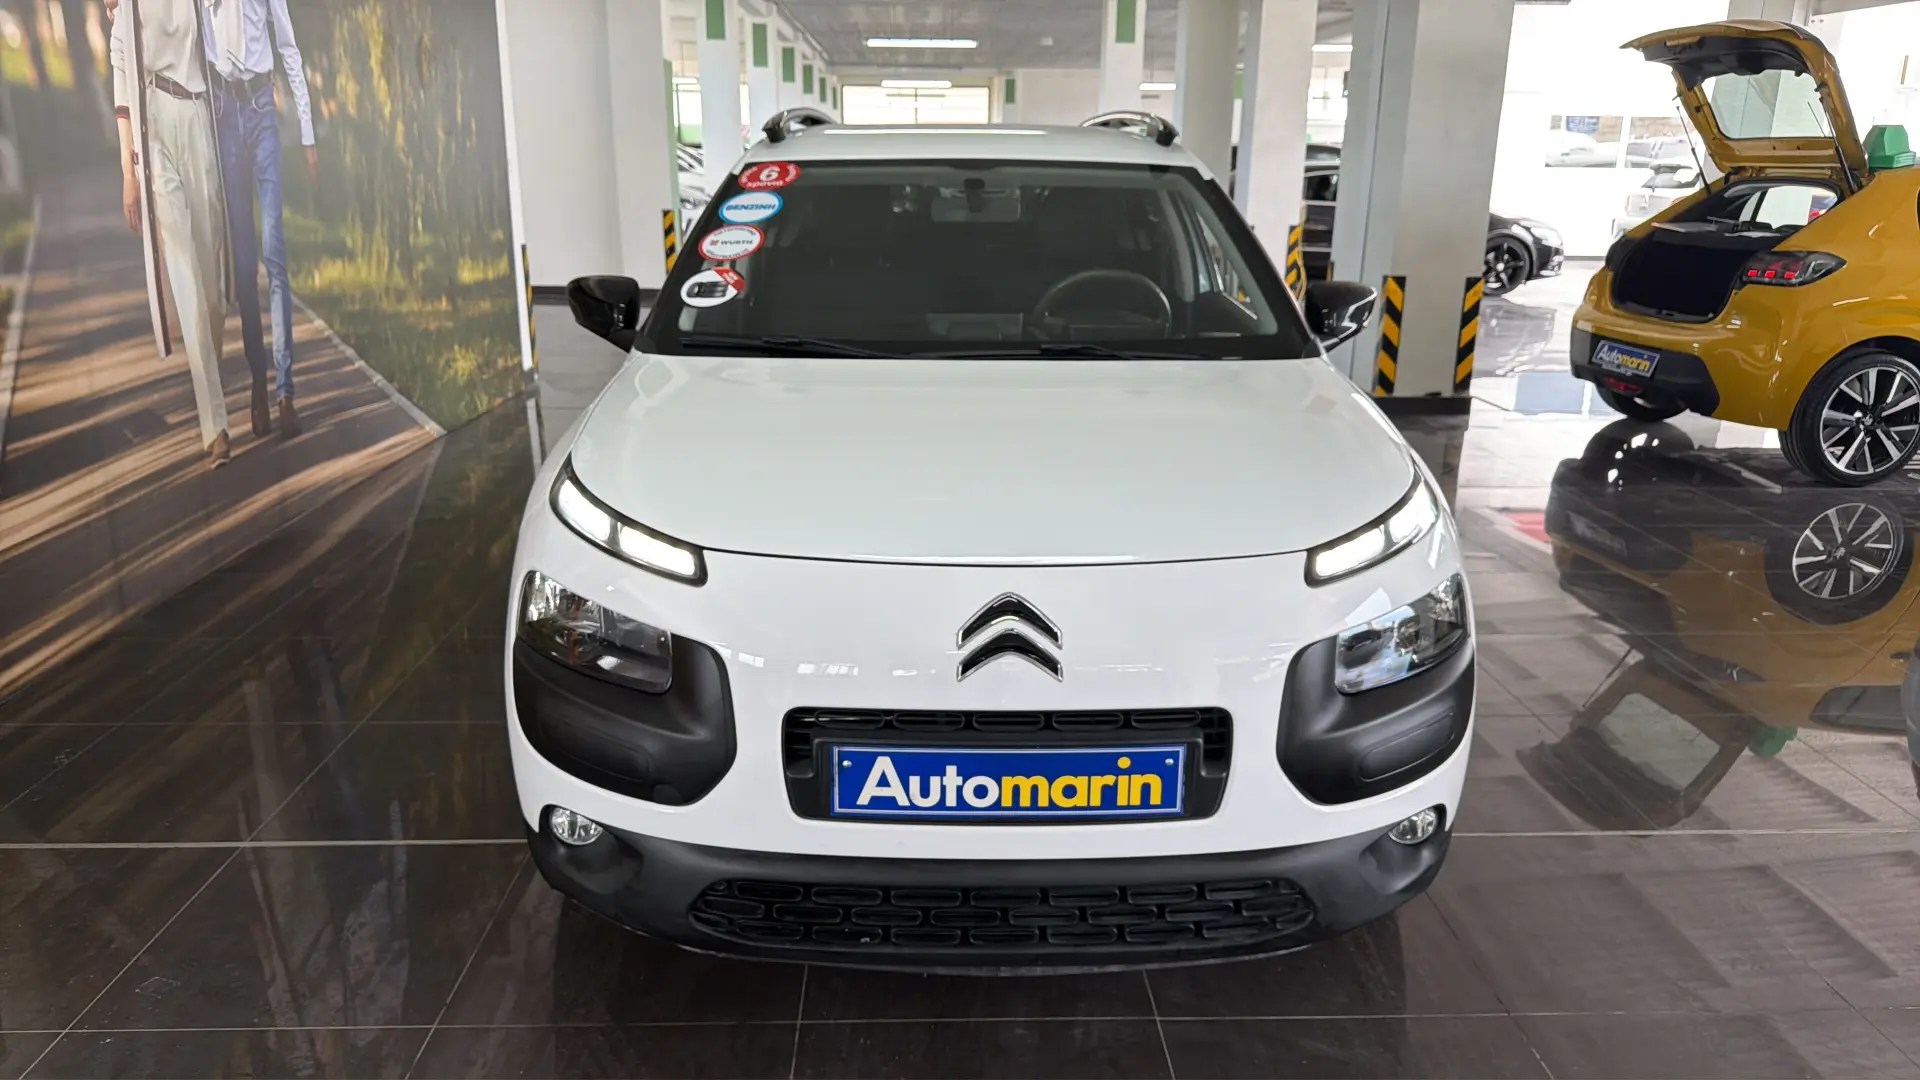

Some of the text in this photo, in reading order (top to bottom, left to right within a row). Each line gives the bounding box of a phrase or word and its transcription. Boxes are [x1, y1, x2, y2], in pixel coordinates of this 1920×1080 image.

[759, 165, 781, 181] 6
[1596, 344, 1651, 373] Automarin
[856, 756, 1162, 808] Automarin
